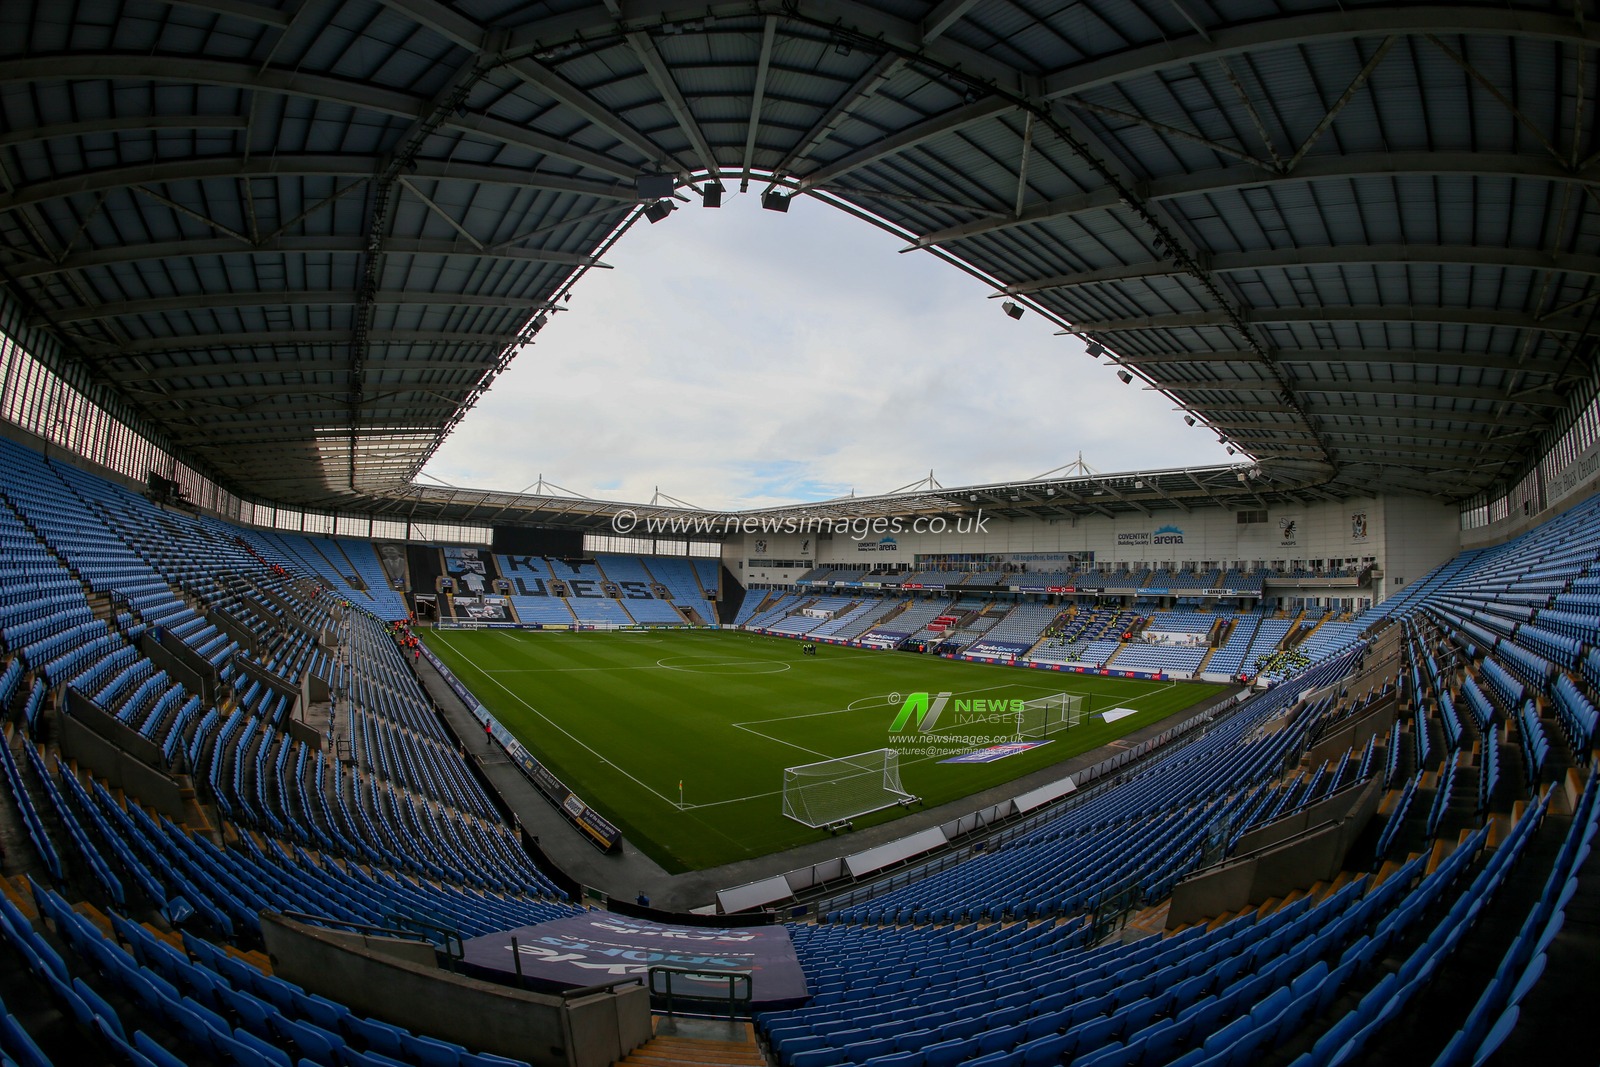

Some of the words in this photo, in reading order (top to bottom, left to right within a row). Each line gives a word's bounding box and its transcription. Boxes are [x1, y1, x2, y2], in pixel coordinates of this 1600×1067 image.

[1154, 536, 1184, 544] arena
[976, 644, 1022, 652] BoyleSports
[531, 936, 750, 967] Sports
